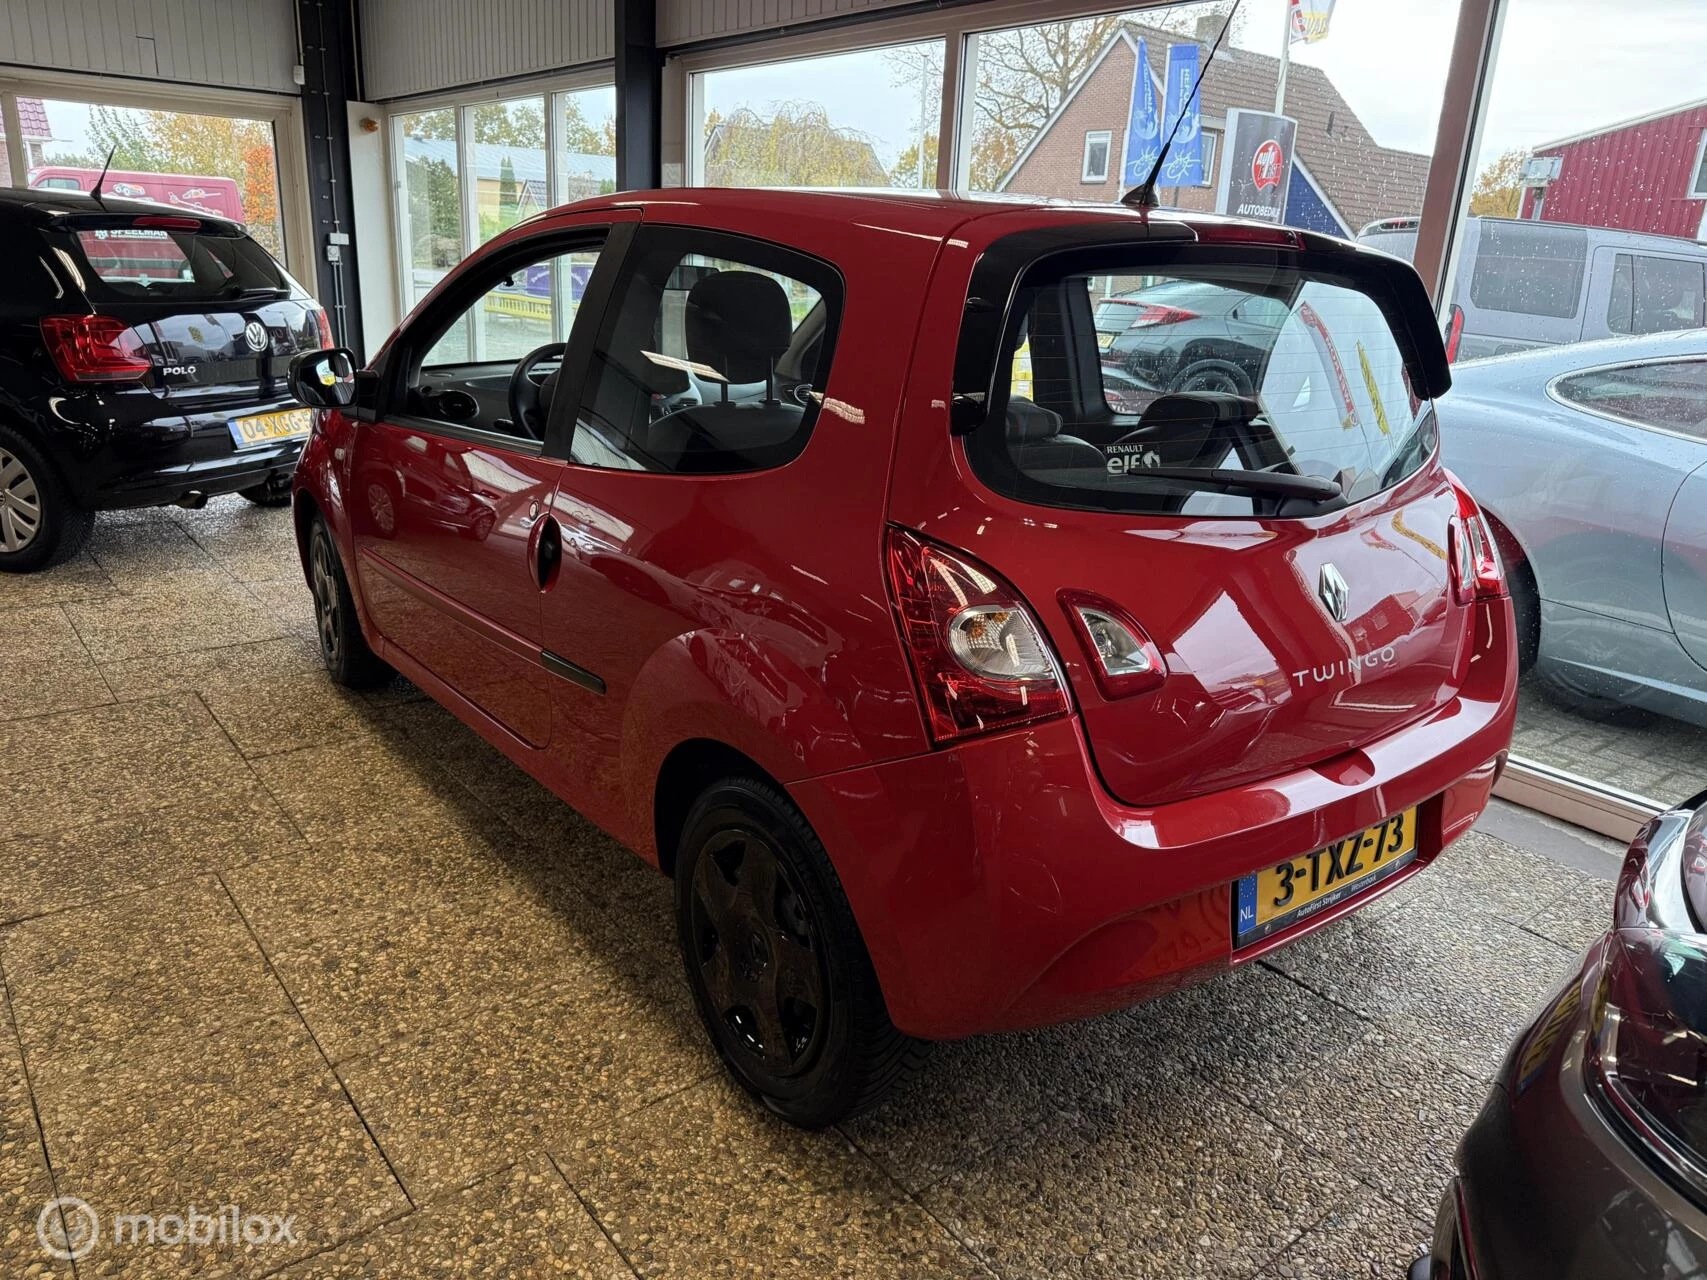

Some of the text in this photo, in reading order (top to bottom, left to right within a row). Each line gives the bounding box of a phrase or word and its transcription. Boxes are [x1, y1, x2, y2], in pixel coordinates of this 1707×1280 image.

[163, 365, 197, 376] POLO
[1106, 444, 1144, 454] RENAULT
[1106, 454, 1140, 474] elf
[1292, 646, 1395, 687] TWINGO
[1274, 813, 1404, 907] 3-TXZ-73
[1240, 909, 1254, 924] NL
